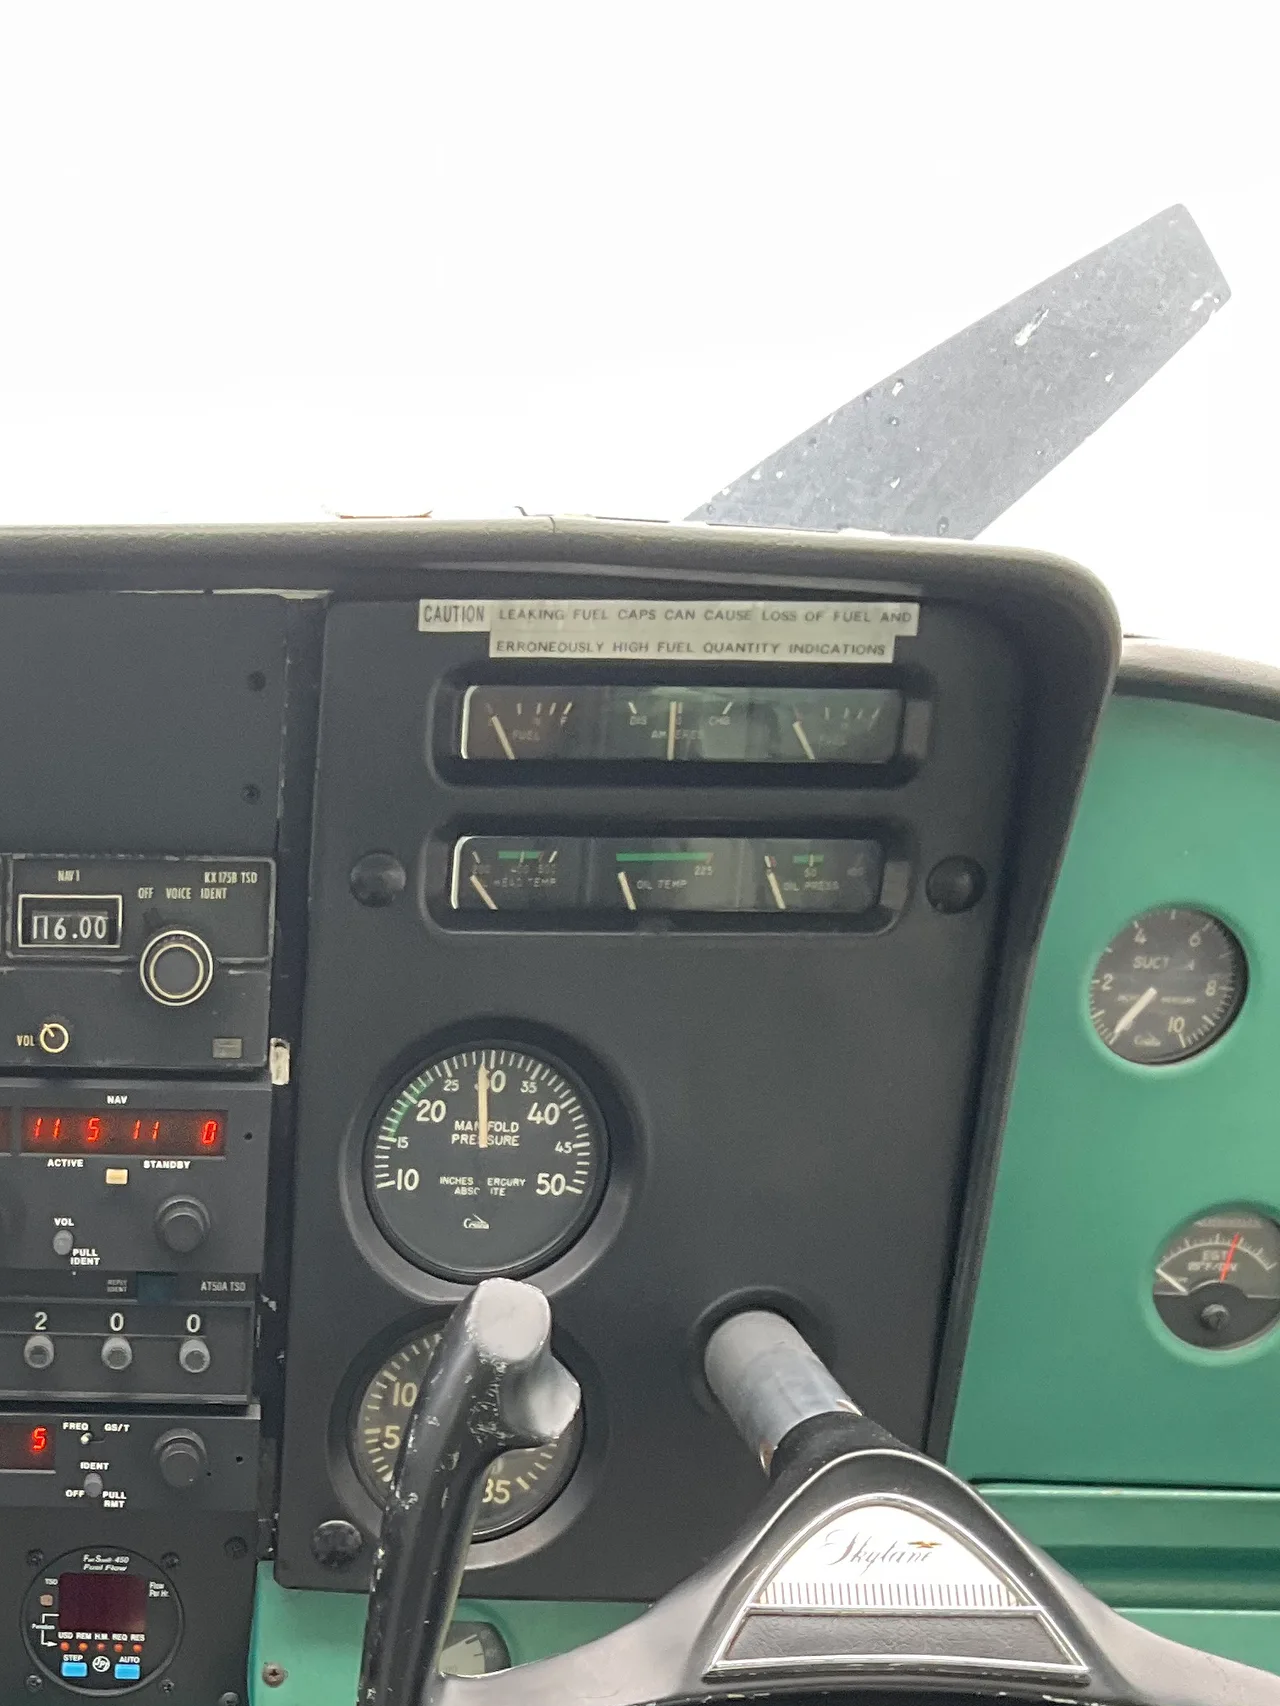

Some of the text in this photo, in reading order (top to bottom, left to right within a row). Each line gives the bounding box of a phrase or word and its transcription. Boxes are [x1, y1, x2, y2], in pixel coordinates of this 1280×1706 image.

[423, 605, 912, 624] CAUTION LEAKING FUEL CAPS CAN CAUSE LOSS OF FUEL AND
[496, 641, 885, 656] ERRONEOUSLY HIGH FUEL QUANTITY INDICATIONS
[138, 888, 227, 899] OFF VOICE IDENT
[17, 1035, 35, 1047] VOL
[443, 1080, 459, 1091] 25
[521, 1082, 537, 1093] 35
[107, 1096, 127, 1104] NAV
[416, 1099, 446, 1123] 20
[527, 1102, 560, 1125] 40
[397, 1136, 409, 1148] 15
[554, 1141, 572, 1153] 45
[47, 1159, 83, 1168] ACTIVE
[143, 1161, 190, 1169] STANDBY
[396, 1168, 419, 1191] 10
[440, 1176, 474, 1185] INCHES
[536, 1173, 566, 1196] 50
[54, 1218, 74, 1227] VOL
[73, 1249, 98, 1257] PULL
[71, 1257, 100, 1265] IDENT
[35, 1312, 48, 1330] 2
[63, 1422, 129, 1433] FREQ GS/T
[80, 1462, 109, 1471] IDENT
[66, 1489, 84, 1498] OFF
[102, 1491, 126, 1500] PULL
[104, 1500, 124, 1509] RMT
[822, 1530, 934, 1576] Skylane
[119, 1656, 140, 1664] AUTO
